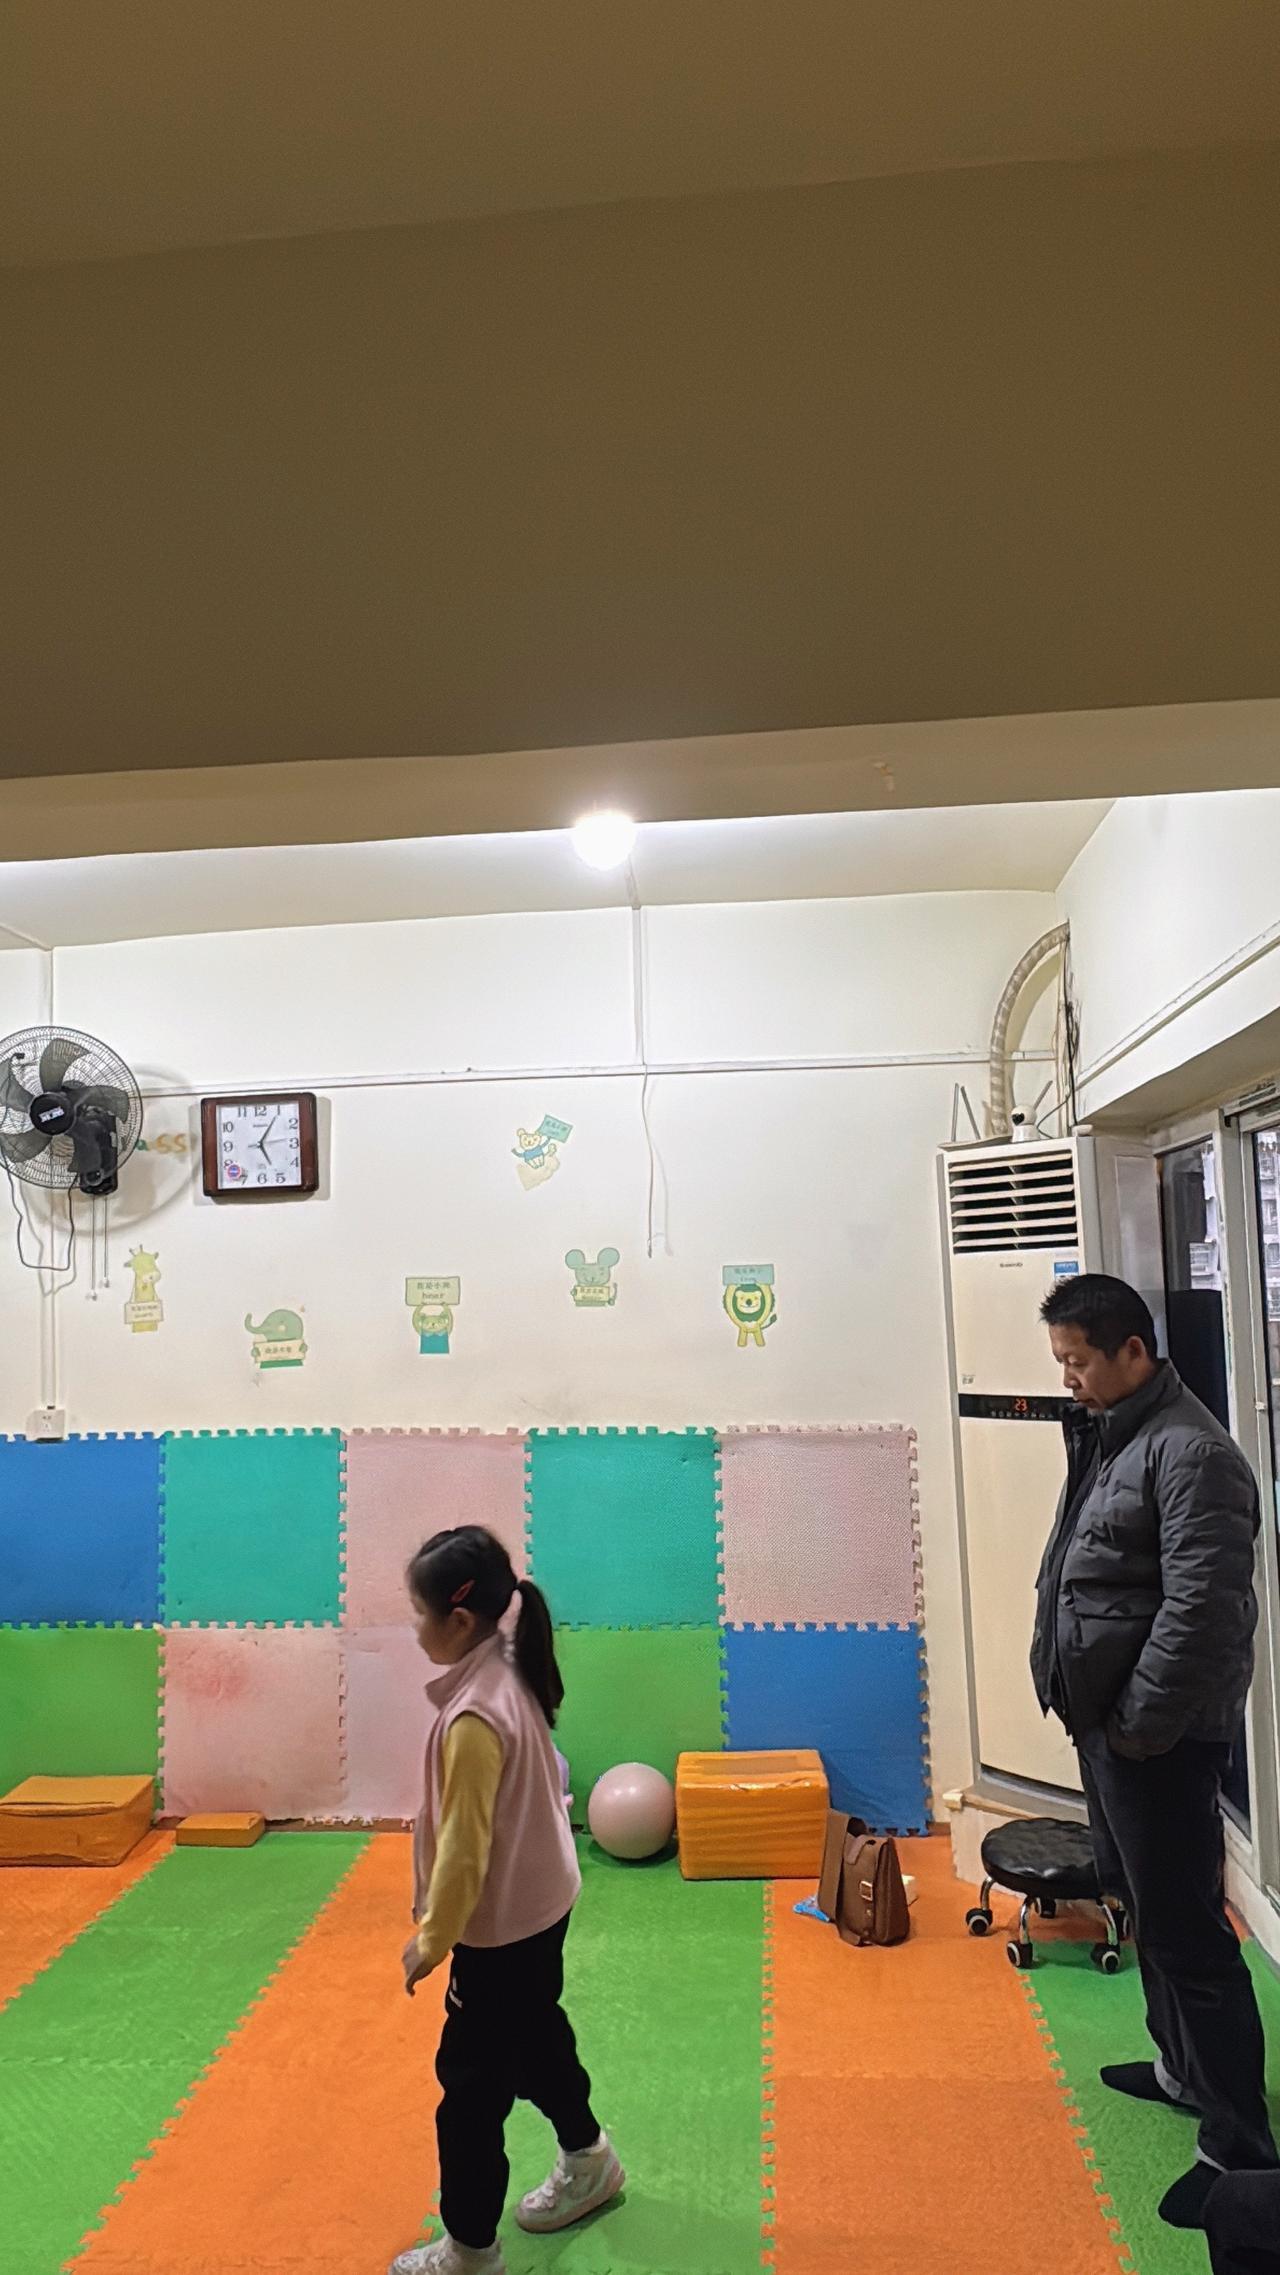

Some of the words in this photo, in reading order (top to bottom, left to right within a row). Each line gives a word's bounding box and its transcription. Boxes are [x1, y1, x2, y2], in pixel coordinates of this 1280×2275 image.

[238, 1105, 247, 1117] 11
[254, 1104, 267, 1117] 12
[223, 1121, 234, 1133] 10
[288, 1117, 299, 1130] 2
[223, 1141, 234, 1153] 9
[289, 1137, 300, 1150] 3
[289, 1156, 299, 1168] 4
[257, 1172, 268, 1185] 6
[275, 1172, 286, 1184] 5
[1014, 1398, 1028, 1412] 23
